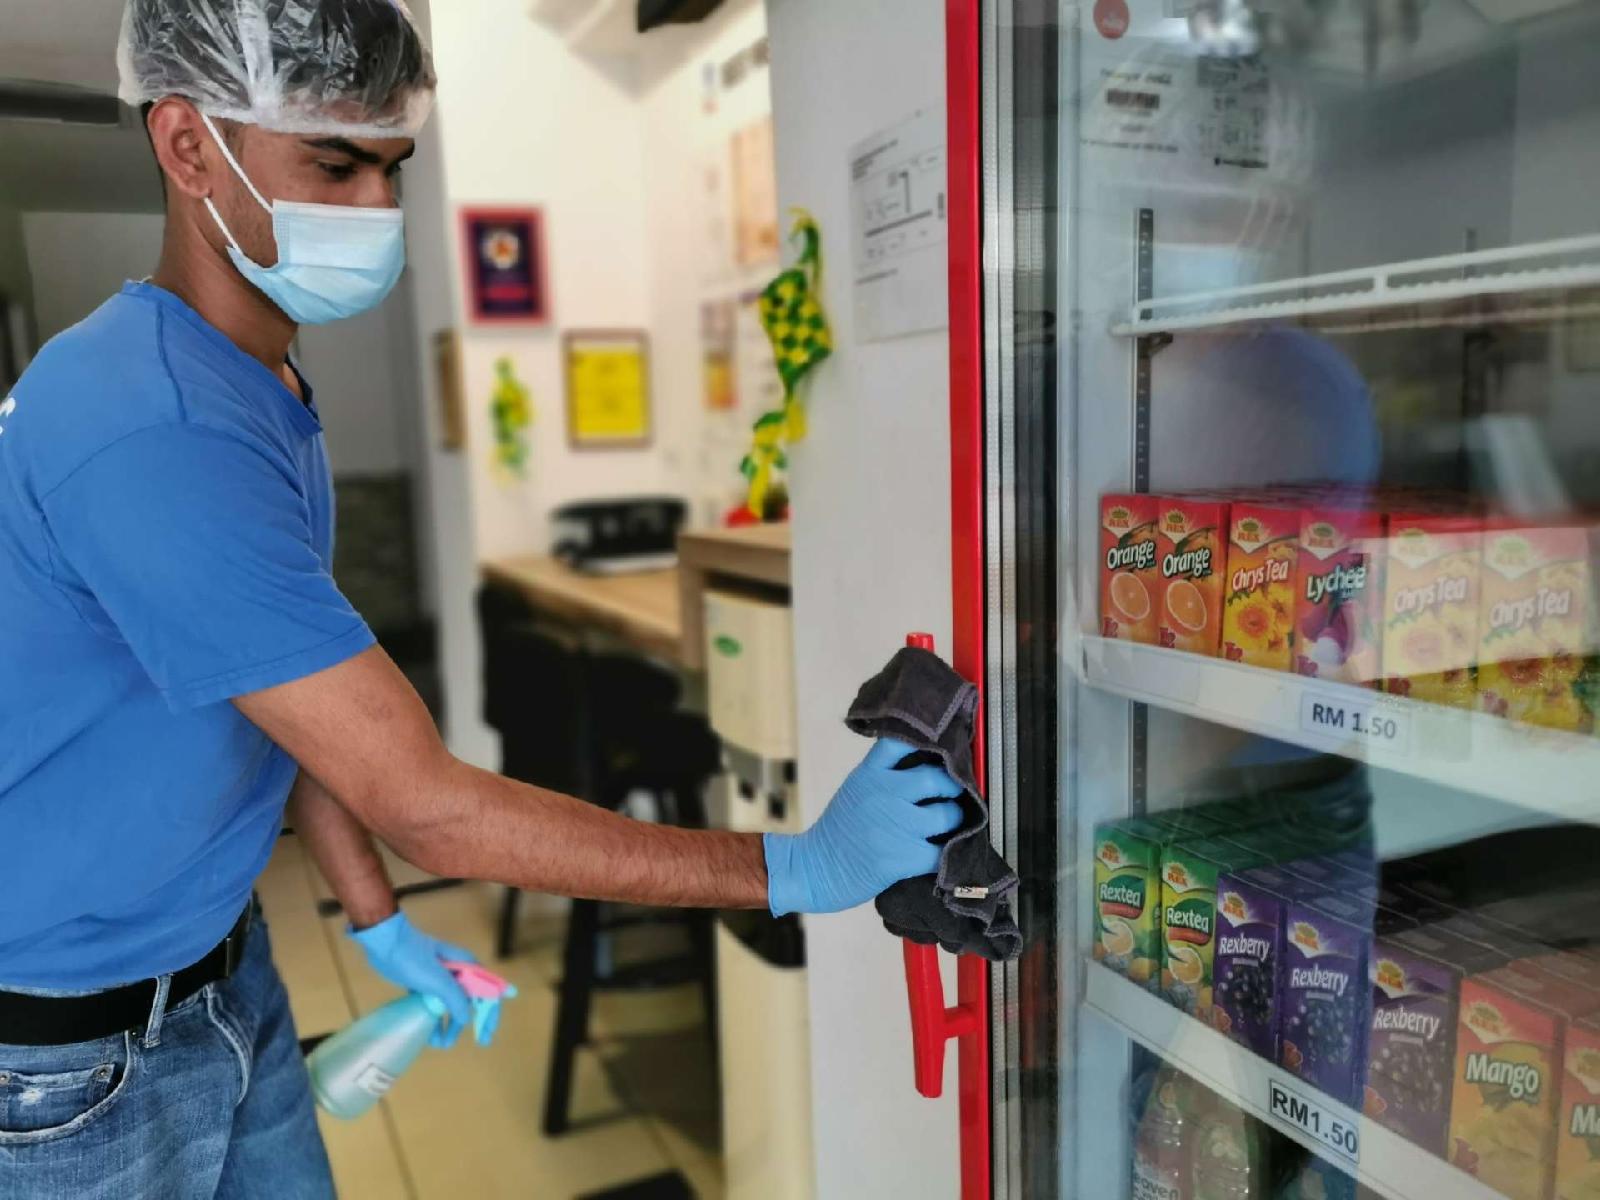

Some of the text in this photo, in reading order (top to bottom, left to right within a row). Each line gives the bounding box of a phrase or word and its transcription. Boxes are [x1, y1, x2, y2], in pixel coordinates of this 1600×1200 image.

[1107, 540, 1155, 569] Orange
[1163, 548, 1210, 577] Orange
[1265, 559, 1289, 582] Tea
[1307, 565, 1367, 602] Lychee
[1435, 576, 1467, 601] Tea
[1536, 588, 1570, 617] Tea
[1312, 703, 1396, 739] RM 1.50
[1100, 883, 1141, 908] Rextea
[1167, 907, 1209, 934] Rextea
[1219, 932, 1270, 962] Rexberry
[1291, 963, 1349, 997] Rexberry
[1373, 1003, 1440, 1040] Rexberry
[1466, 1053, 1539, 1098] Mango
[1272, 1087, 1358, 1154] RM1.50
